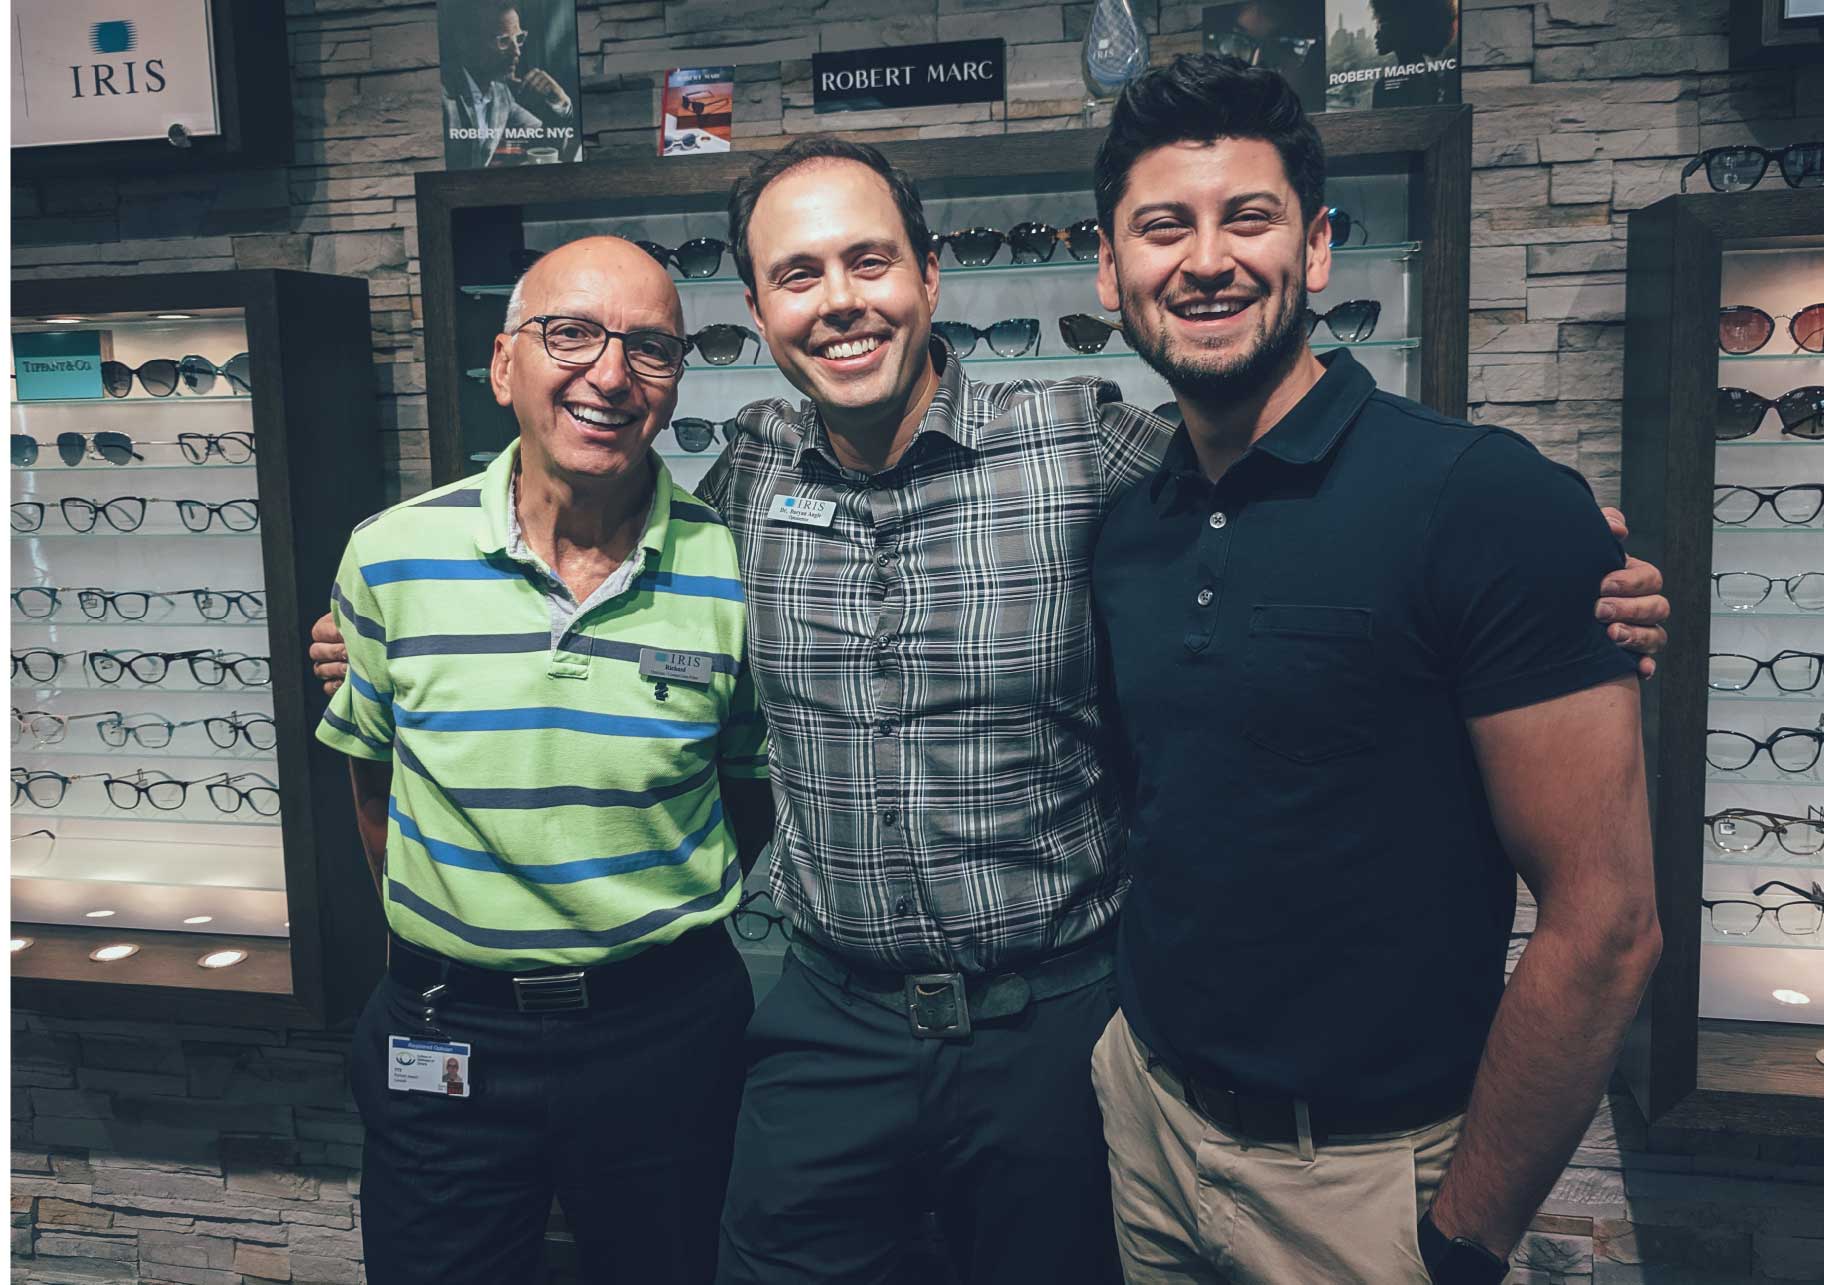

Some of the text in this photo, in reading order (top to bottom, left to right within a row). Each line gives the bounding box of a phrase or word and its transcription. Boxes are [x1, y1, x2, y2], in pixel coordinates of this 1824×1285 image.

[69, 59, 166, 98] IRIS
[821, 60, 993, 92] ROBERT MARC
[1329, 67, 1381, 85] ROBERT
[1384, 63, 1424, 78] MARC
[1428, 58, 1456, 72] NYC
[449, 127, 574, 139] ROBERT MARC NYC
[798, 499, 826, 511] IRIS
[671, 653, 701, 668] IRIS
